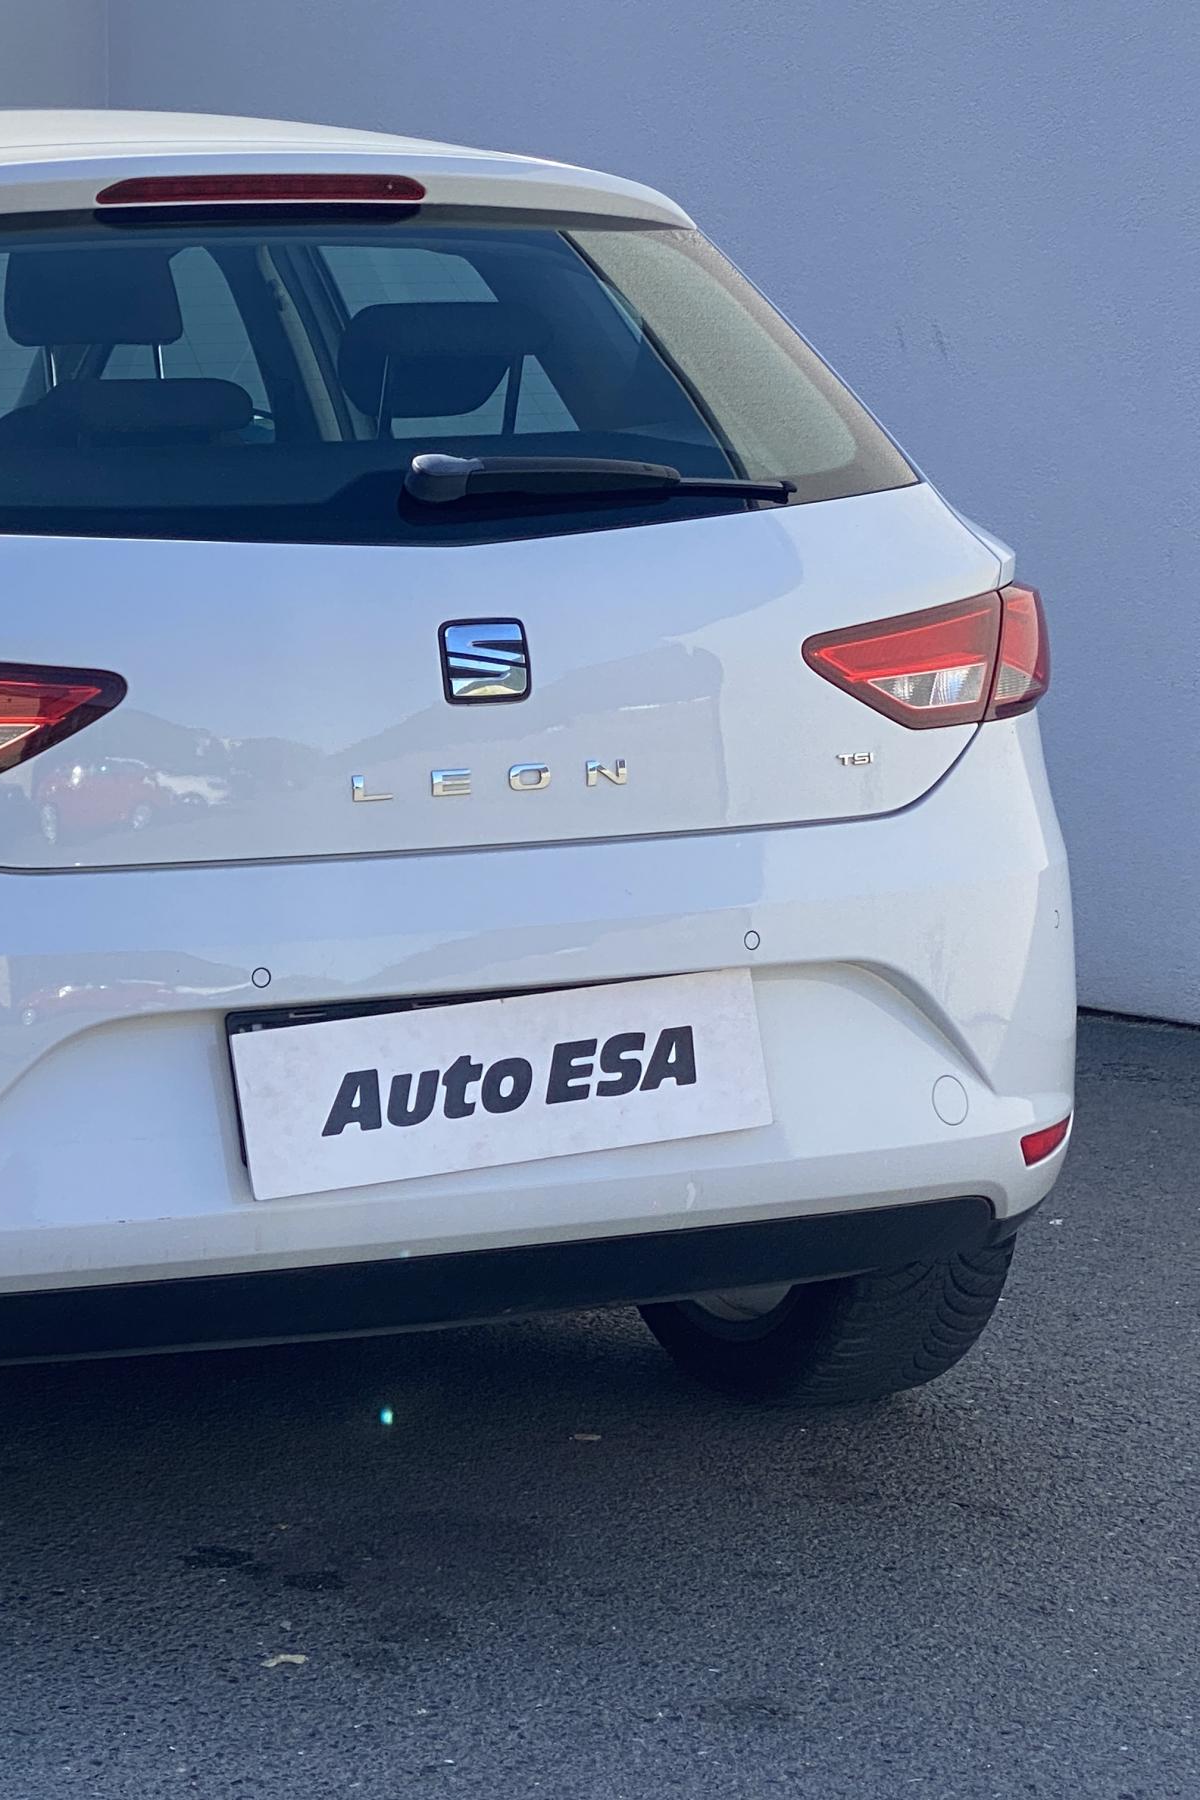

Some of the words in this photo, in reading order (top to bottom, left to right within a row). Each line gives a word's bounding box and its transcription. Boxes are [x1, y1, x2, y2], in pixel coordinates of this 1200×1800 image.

[352, 759, 627, 802] LEON
[836, 752, 874, 766] TSI
[321, 1055, 533, 1137] Auto
[545, 1025, 697, 1105] ESA
